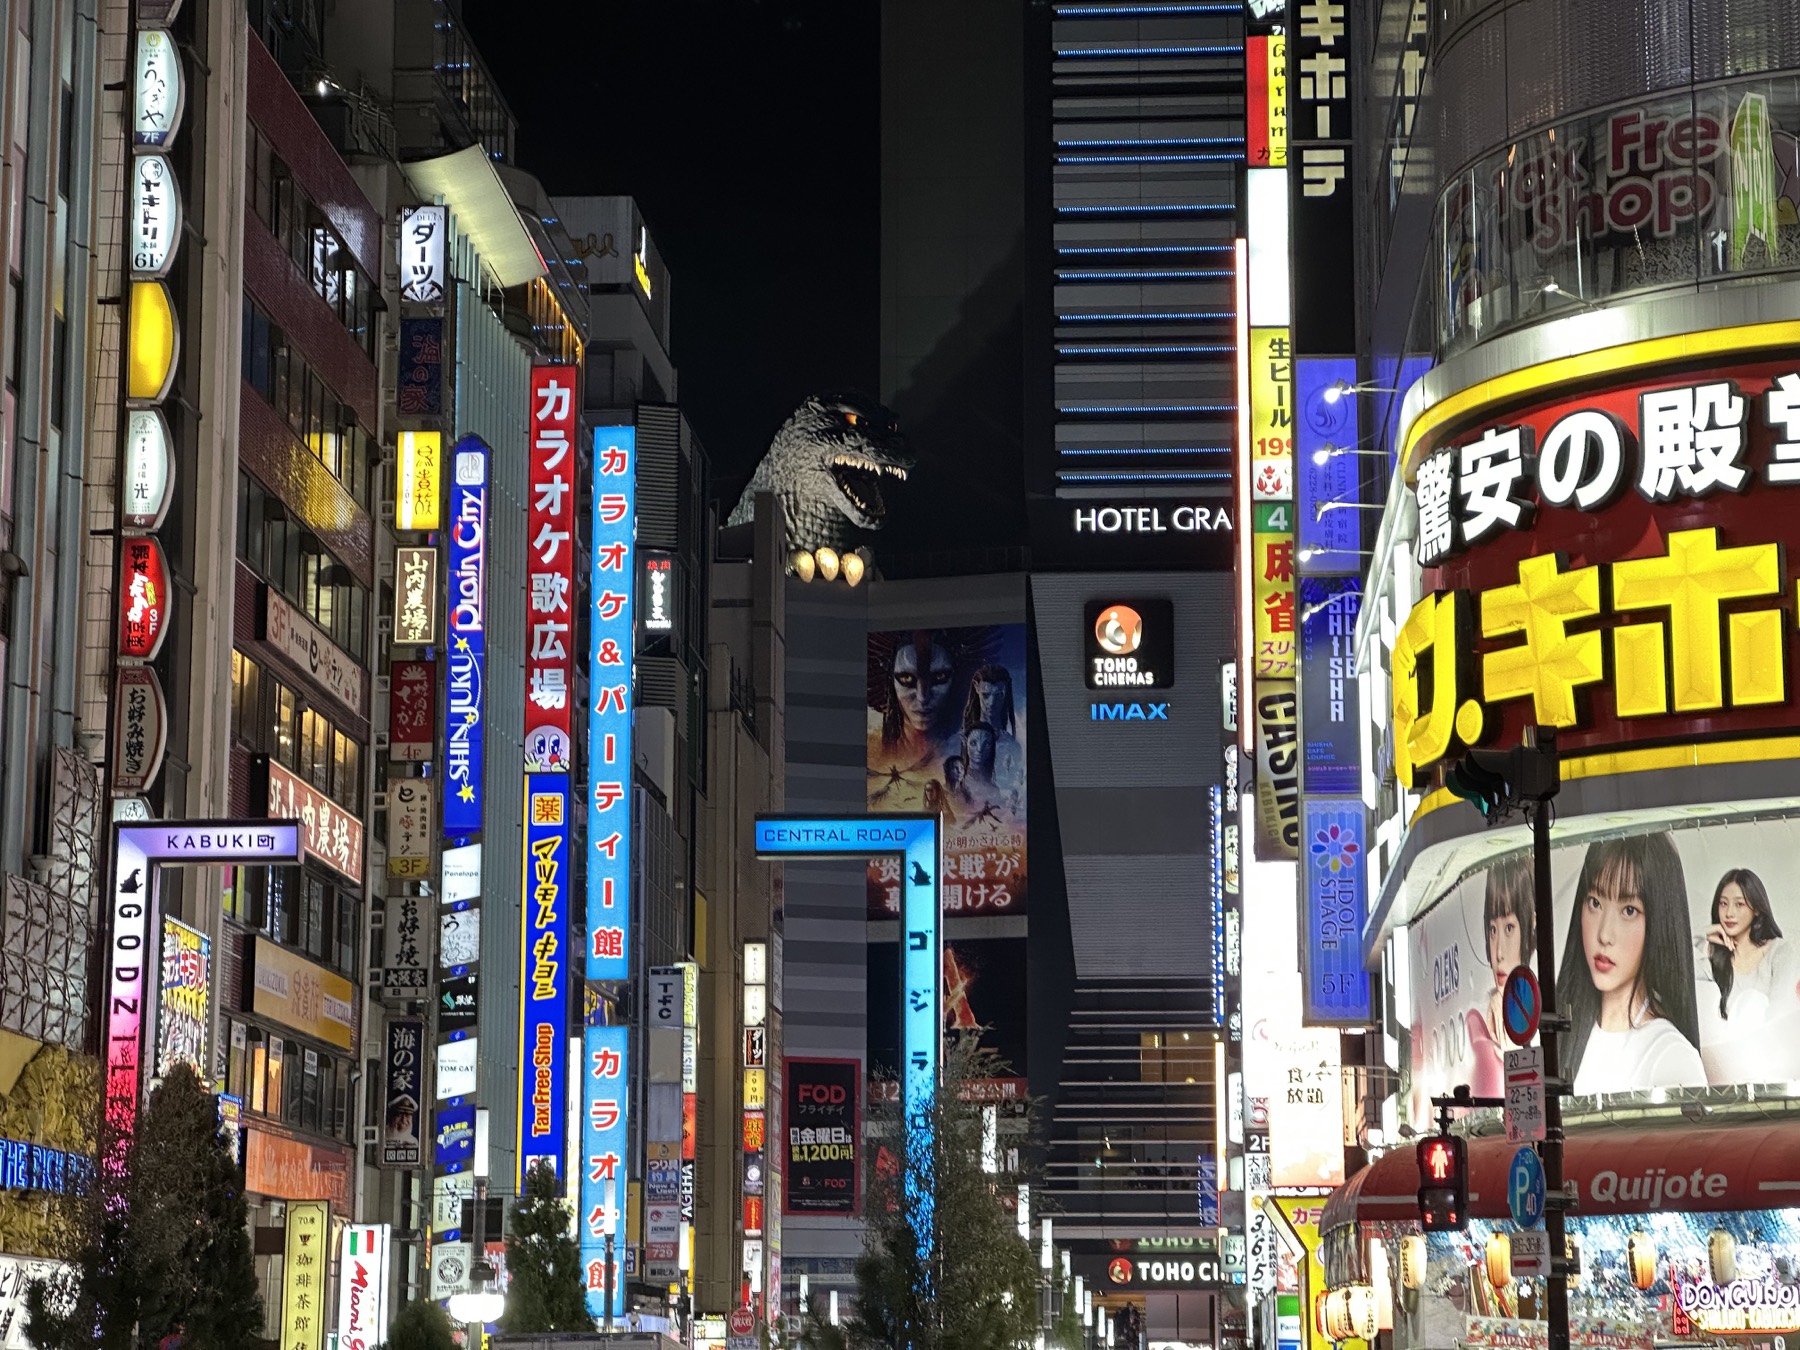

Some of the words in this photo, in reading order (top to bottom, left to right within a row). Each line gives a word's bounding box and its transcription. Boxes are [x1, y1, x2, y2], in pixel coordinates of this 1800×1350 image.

[413, 222, 435, 286] ダーツ
[1268, 338, 1291, 428] 生ビール
[1074, 507, 1167, 532] HOTEL
[1267, 506, 1289, 531] 4
[529, 379, 571, 711] カラオケ歌広場
[408, 628, 422, 640] 5F
[1094, 657, 1137, 682] TOHO
[1094, 681, 1154, 696] CINEMAS
[592, 446, 628, 960] カラオケ&パーティー館
[1090, 703, 1168, 721] IMAX
[449, 655, 480, 781] SHINJUKU
[402, 744, 422, 760] 4F
[534, 796, 562, 824] 薬
[764, 829, 850, 842] CENTRAL
[857, 828, 907, 841] ROAD
[399, 859, 422, 874] 3F
[1320, 878, 1338, 950] STAGE
[1338, 879, 1355, 938] IDOL
[1321, 973, 1355, 995] 5F
[534, 1023, 554, 1066] Shop
[393, 1027, 416, 1092] 海の家
[532, 1069, 553, 1104] Free
[798, 1083, 847, 1105] FOD
[532, 1104, 553, 1137] Tax
[824, 1178, 847, 1189] FOD
[1516, 1165, 1530, 1217] P
[1590, 1167, 1728, 1208] Quijote
[1138, 1261, 1194, 1281] TOHO
[1493, 1335, 1531, 1347] JAPAN
[1589, 1334, 1627, 1347] JAPAN
